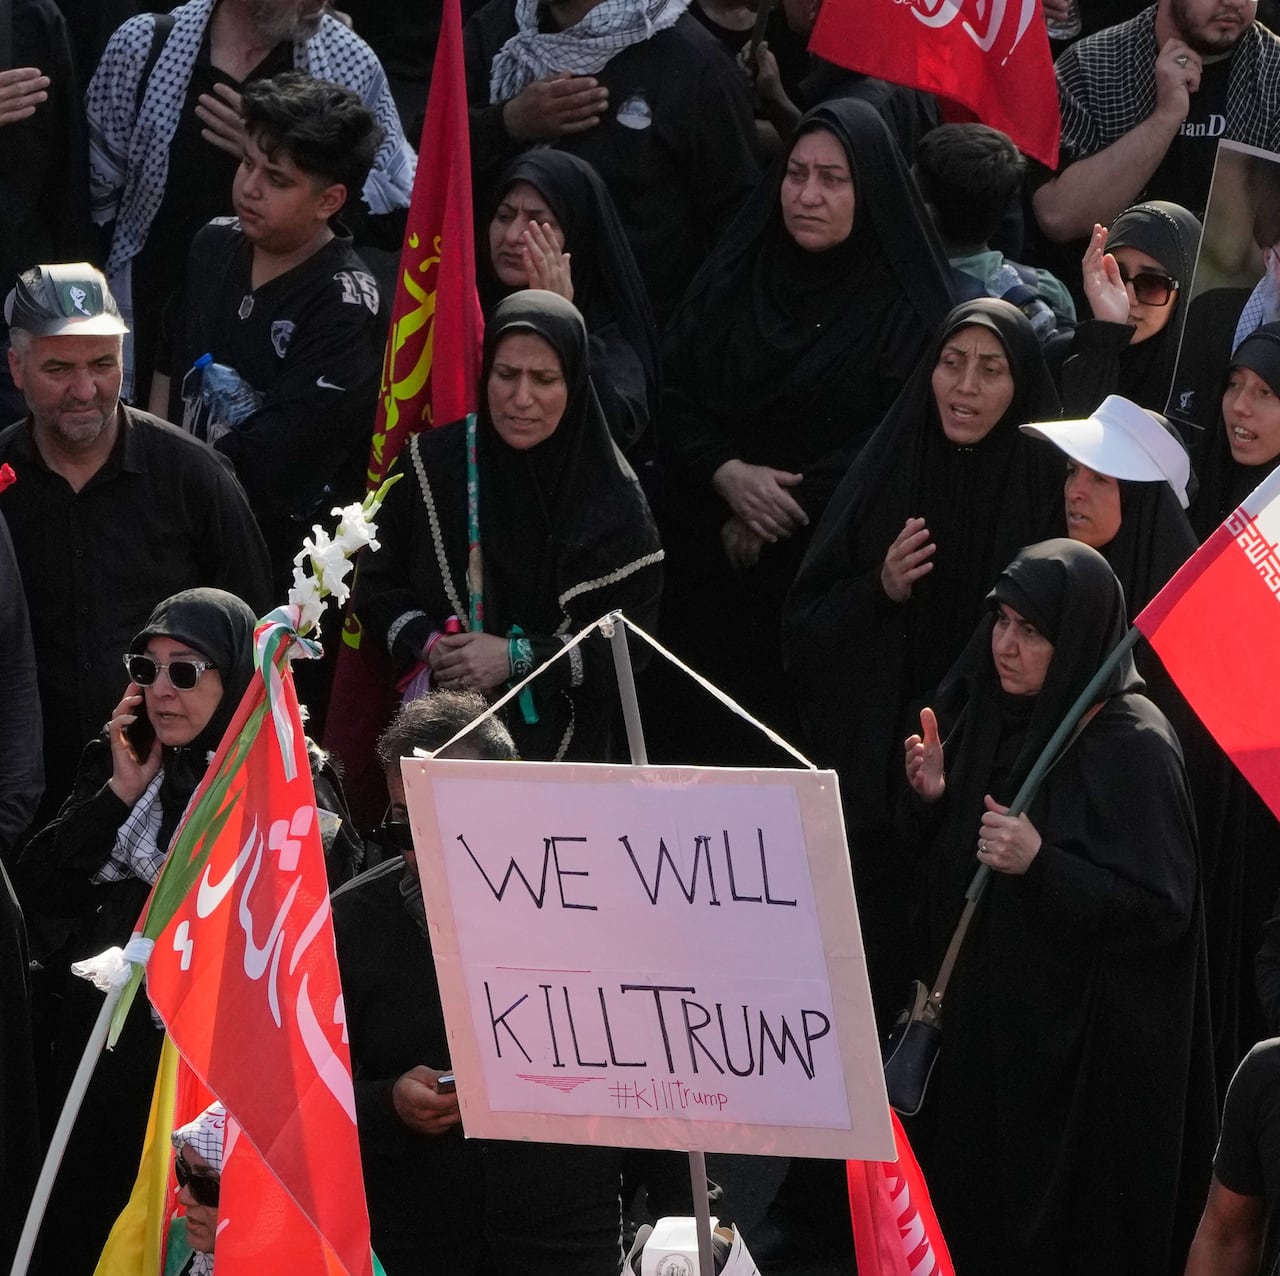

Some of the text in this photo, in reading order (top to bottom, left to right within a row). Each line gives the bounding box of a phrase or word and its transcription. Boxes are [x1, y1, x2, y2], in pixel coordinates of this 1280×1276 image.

[333, 270, 380, 316] 15
[456, 828, 797, 911] WE WILL
[608, 1077, 729, 1112] #killtrump
